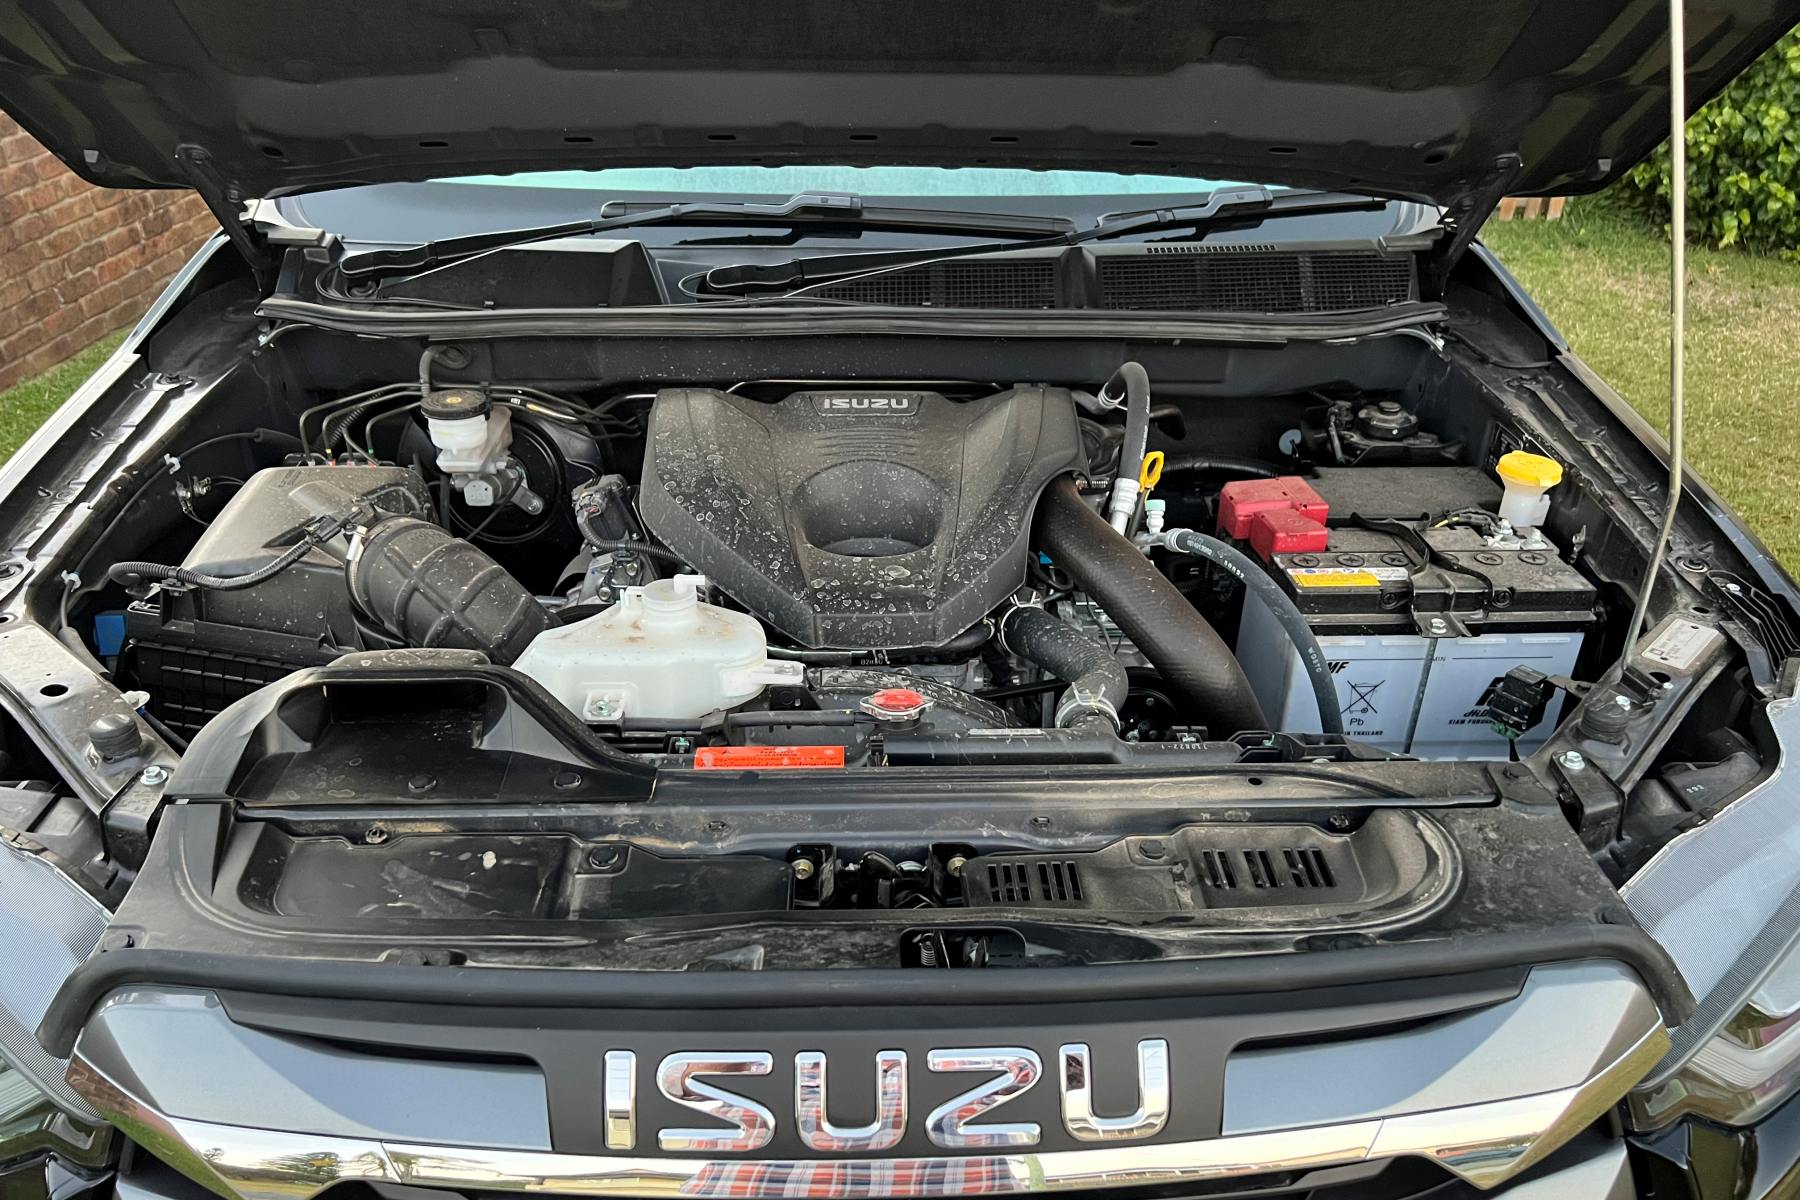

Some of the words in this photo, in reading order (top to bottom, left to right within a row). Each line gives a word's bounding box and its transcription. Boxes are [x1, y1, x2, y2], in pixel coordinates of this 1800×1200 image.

[824, 398, 909, 409] ISUZU
[1349, 718, 1364, 726] Pb
[603, 1038, 1170, 1152] ISUZU
